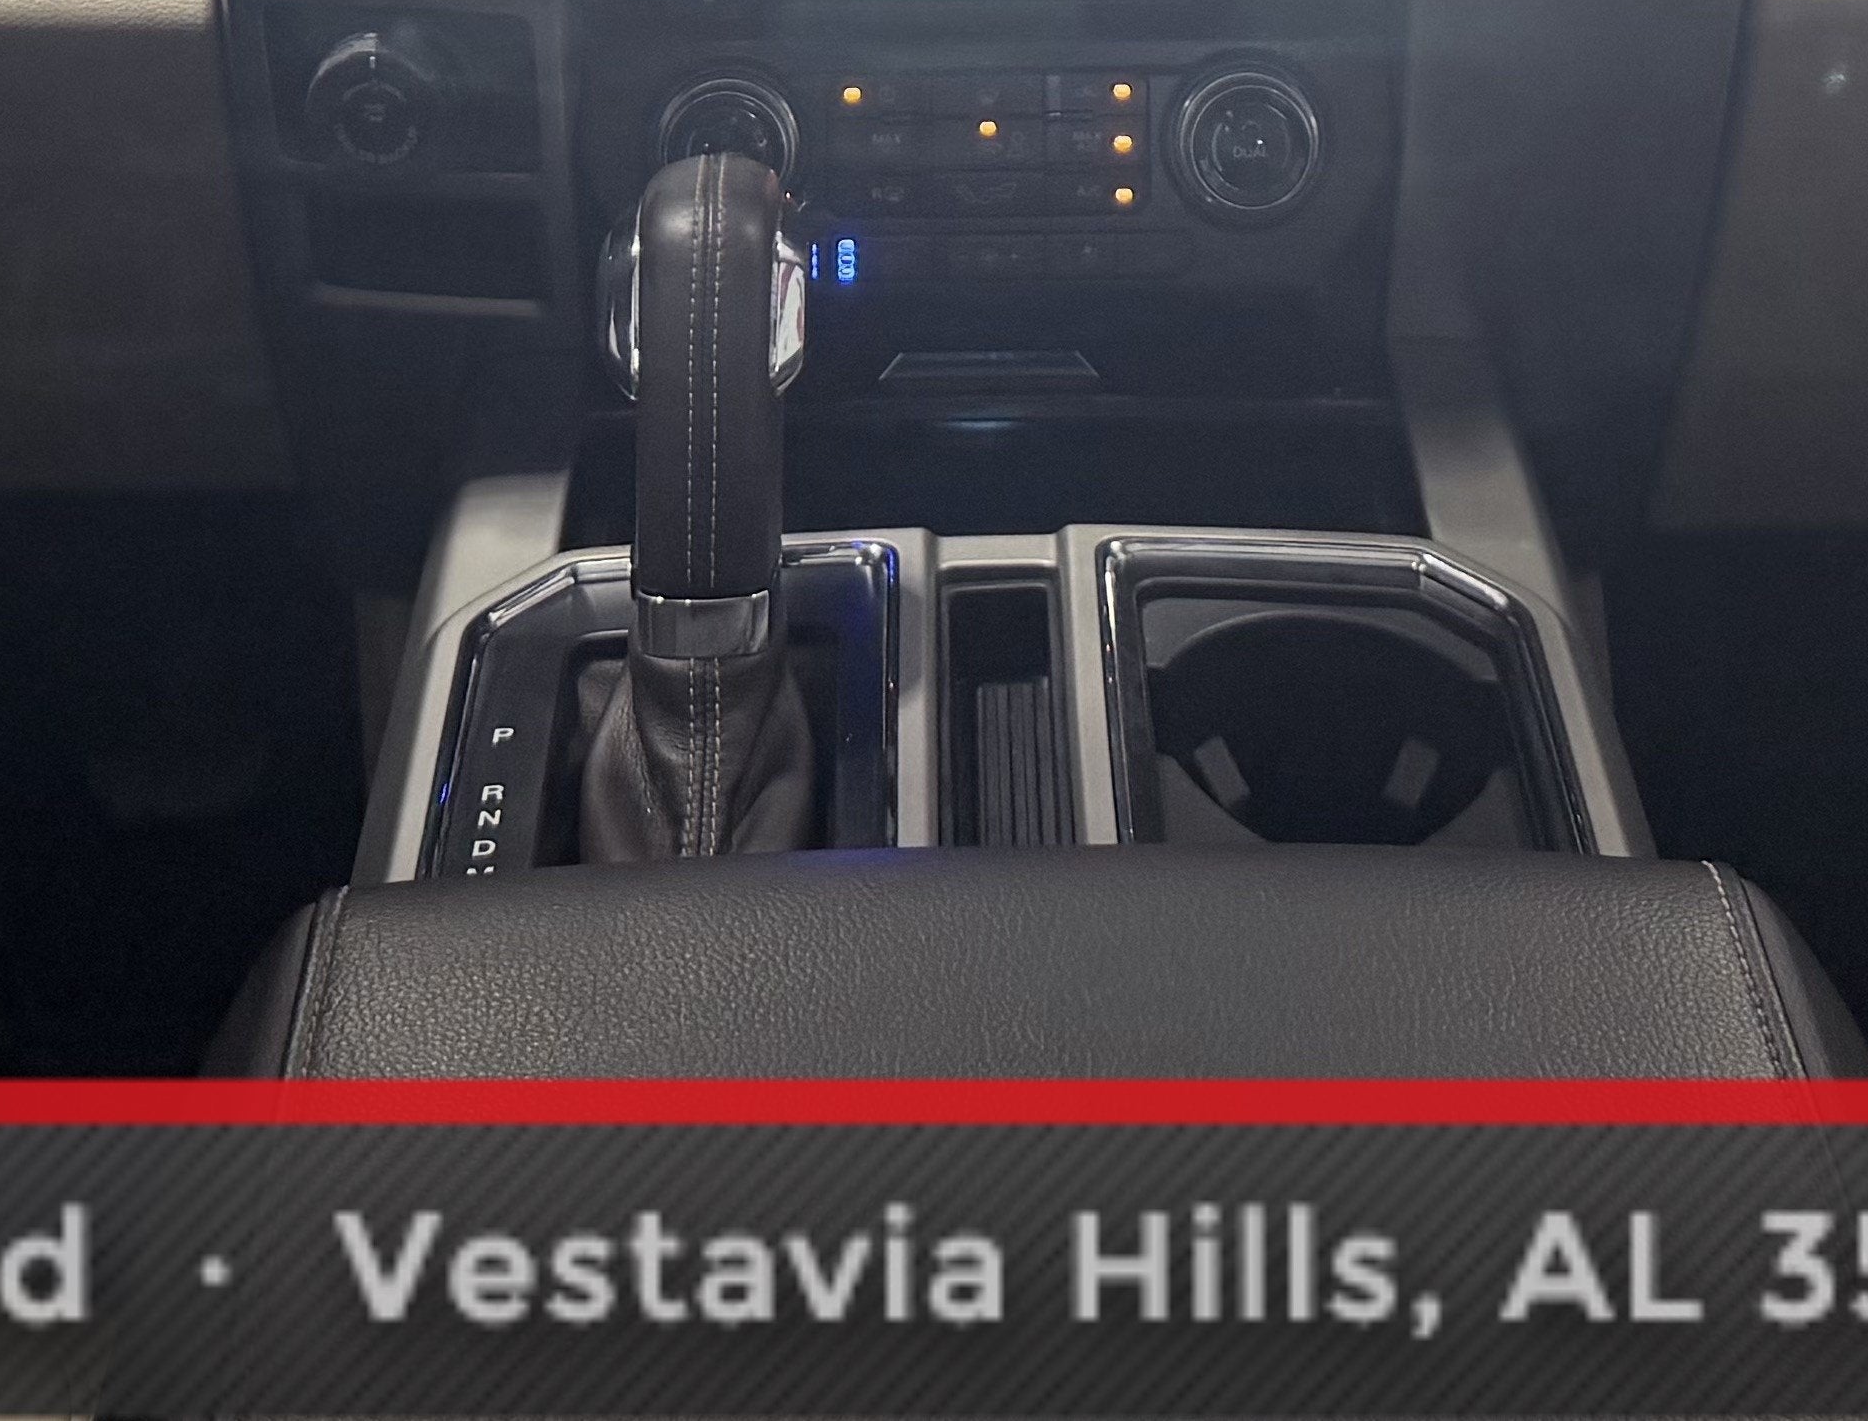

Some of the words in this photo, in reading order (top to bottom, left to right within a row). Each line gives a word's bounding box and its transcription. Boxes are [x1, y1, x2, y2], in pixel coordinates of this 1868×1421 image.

[492, 728, 514, 743] P
[482, 785, 504, 801] R
[477, 810, 501, 827] N
[471, 839, 497, 857] D
